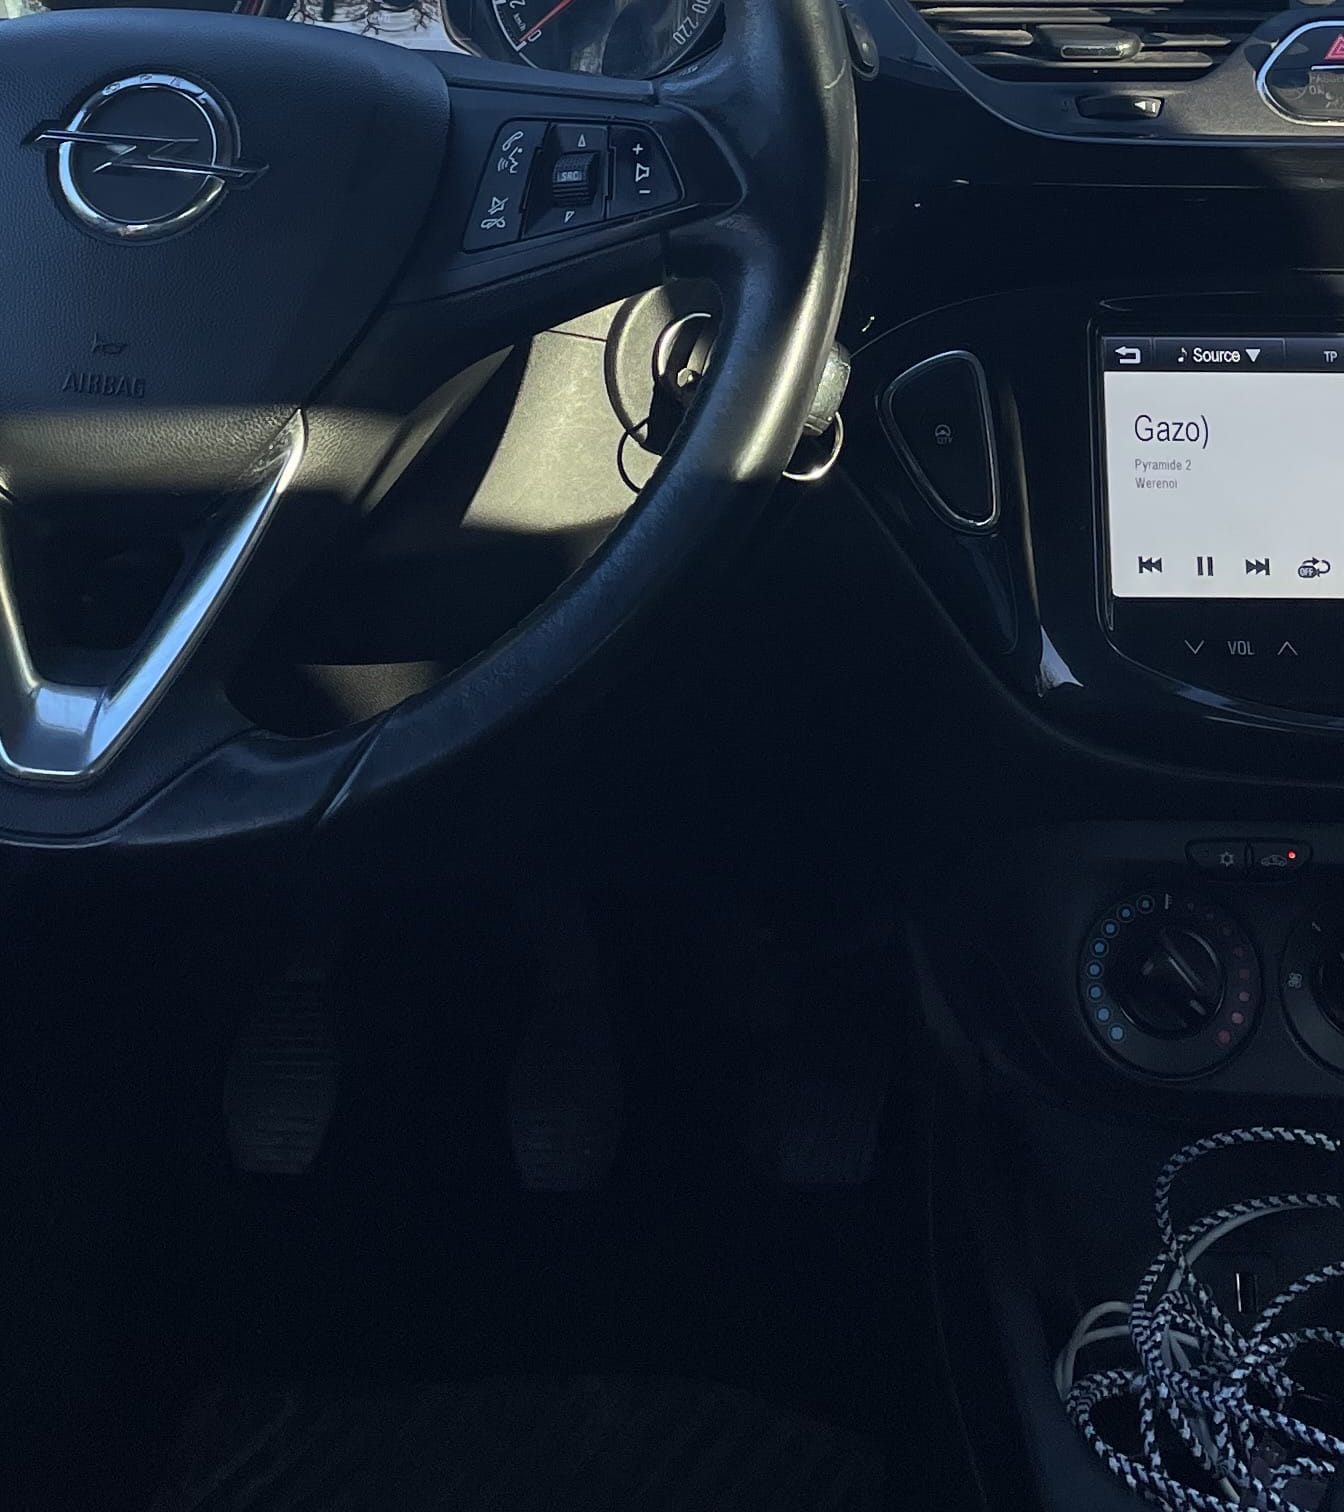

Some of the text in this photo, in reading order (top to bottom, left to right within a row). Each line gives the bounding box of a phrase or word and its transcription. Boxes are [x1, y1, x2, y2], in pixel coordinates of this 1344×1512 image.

[672, 17, 699, 46] 220
[1192, 348, 1241, 364] Source
[1324, 351, 1337, 363] TP
[62, 372, 145, 399] AIRBAG
[1134, 414, 1209, 448] Gazo)
[1134, 458, 1192, 473] Pyramide 2
[1135, 476, 1178, 489] Werenoi
[1226, 640, 1255, 656] VOL
